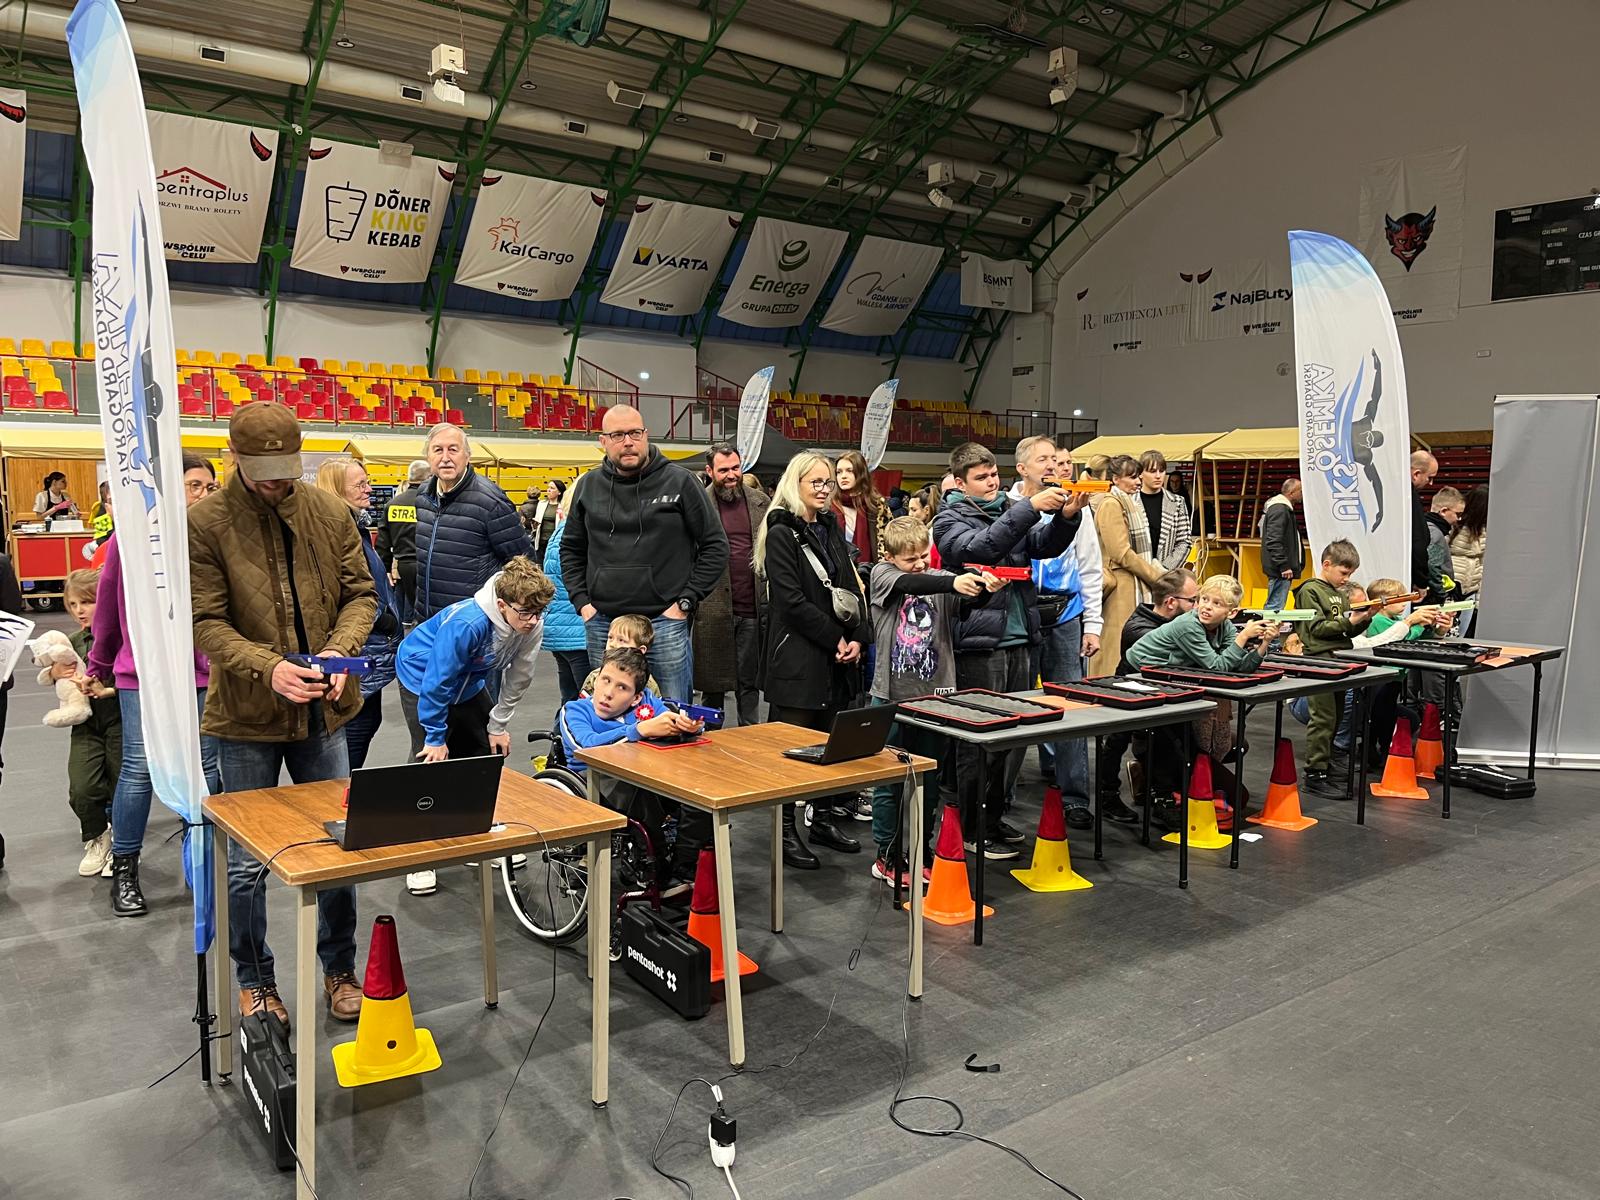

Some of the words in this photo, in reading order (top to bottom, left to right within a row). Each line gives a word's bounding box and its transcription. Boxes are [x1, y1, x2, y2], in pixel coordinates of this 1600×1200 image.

[184, 204, 211, 213] BRAMY
[213, 207, 241, 215] ROLETY
[370, 209, 429, 233] KING
[163, 241, 216, 253] WSPÓLNIE
[367, 230, 422, 248] KEBAB
[181, 251, 206, 259] CELU
[499, 240, 575, 265] KalCargo
[656, 253, 708, 271] VARTA
[749, 274, 810, 298] Energa
[983, 273, 1013, 287] BSMNT
[1230, 287, 1293, 306] NajButy
[741, 302, 771, 313] GRUPA
[1103, 308, 1163, 325] REZYDENCJA
[417, 416, 424, 426] B
[627, 945, 664, 980] pentashot
